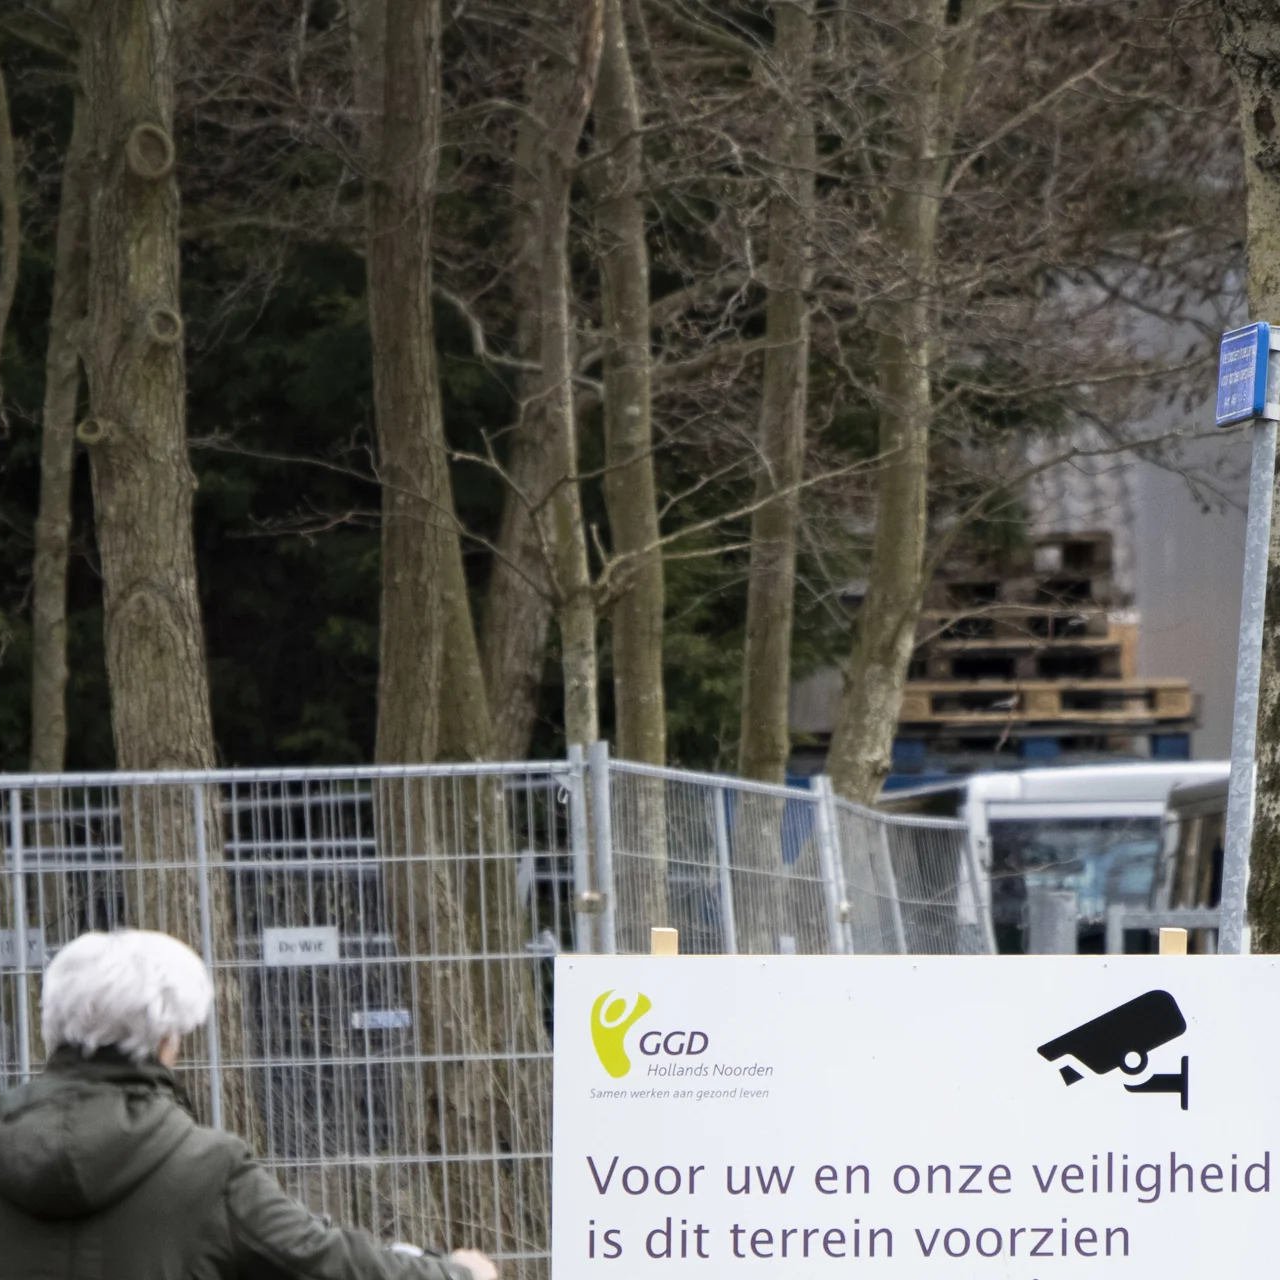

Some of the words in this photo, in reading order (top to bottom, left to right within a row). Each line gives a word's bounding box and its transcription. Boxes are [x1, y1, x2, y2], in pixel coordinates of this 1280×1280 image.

[639, 1030, 709, 1056] GGD
[647, 1063, 709, 1077] Hollands
[712, 1063, 774, 1077] Noorden
[590, 1088, 627, 1099] Samen
[630, 1087, 670, 1099] werken
[673, 1090, 694, 1099] aan
[696, 1087, 737, 1102] gezond
[739, 1087, 769, 1099] leven
[586, 1155, 705, 1196] Voor
[726, 1165, 795, 1195] uw
[814, 1164, 871, 1195] en
[893, 1164, 1013, 1195] onze
[1032, 1150, 1271, 1205] veiligheid
[588, 1219, 623, 1259] is
[645, 1216, 710, 1259] dit
[729, 1218, 894, 1259] terrein
[914, 1217, 1130, 1258] voorzien
